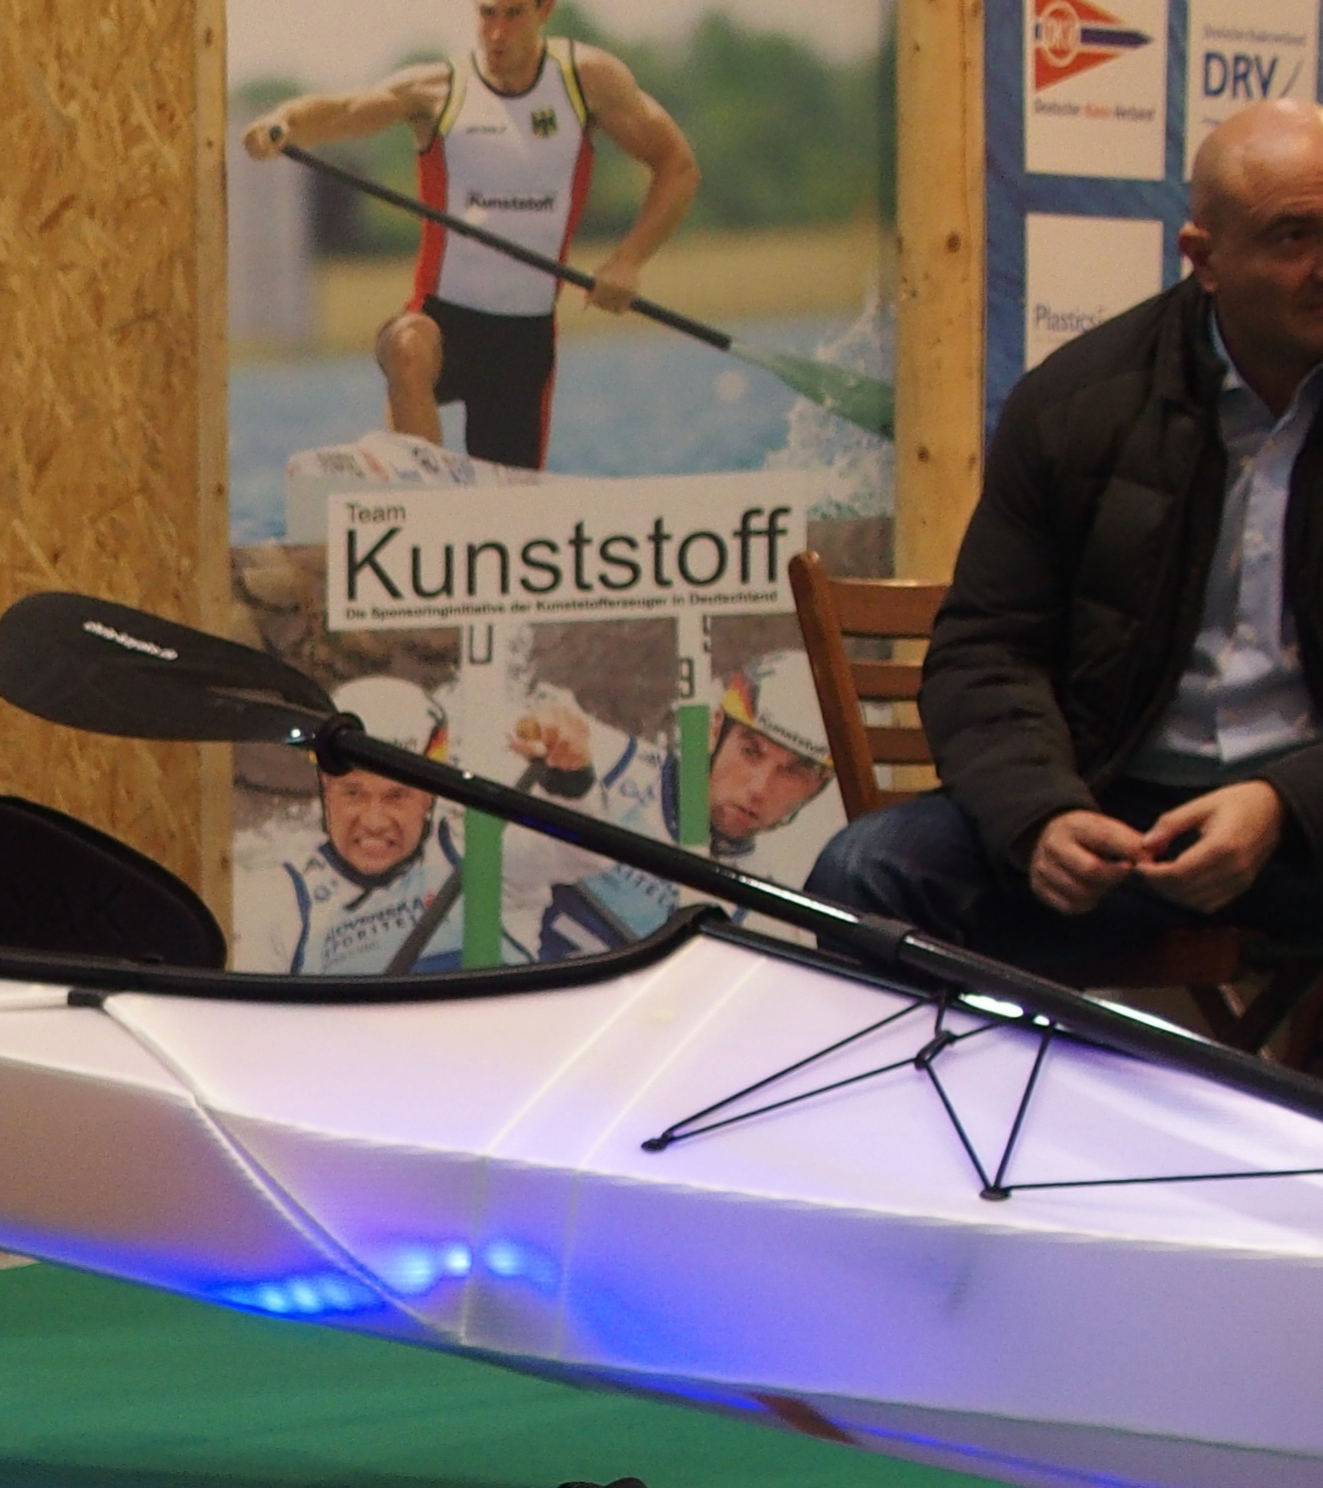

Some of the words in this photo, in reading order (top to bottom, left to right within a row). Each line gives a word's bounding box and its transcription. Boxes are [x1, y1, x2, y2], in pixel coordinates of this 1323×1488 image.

[1203, 51, 1279, 99] DRV
[346, 502, 406, 524] Team
[346, 506, 792, 602] Kunststoff
[346, 607, 367, 620] Die
[511, 601, 531, 613] der
[672, 593, 685, 606] in
[690, 590, 779, 606] Deutschland
